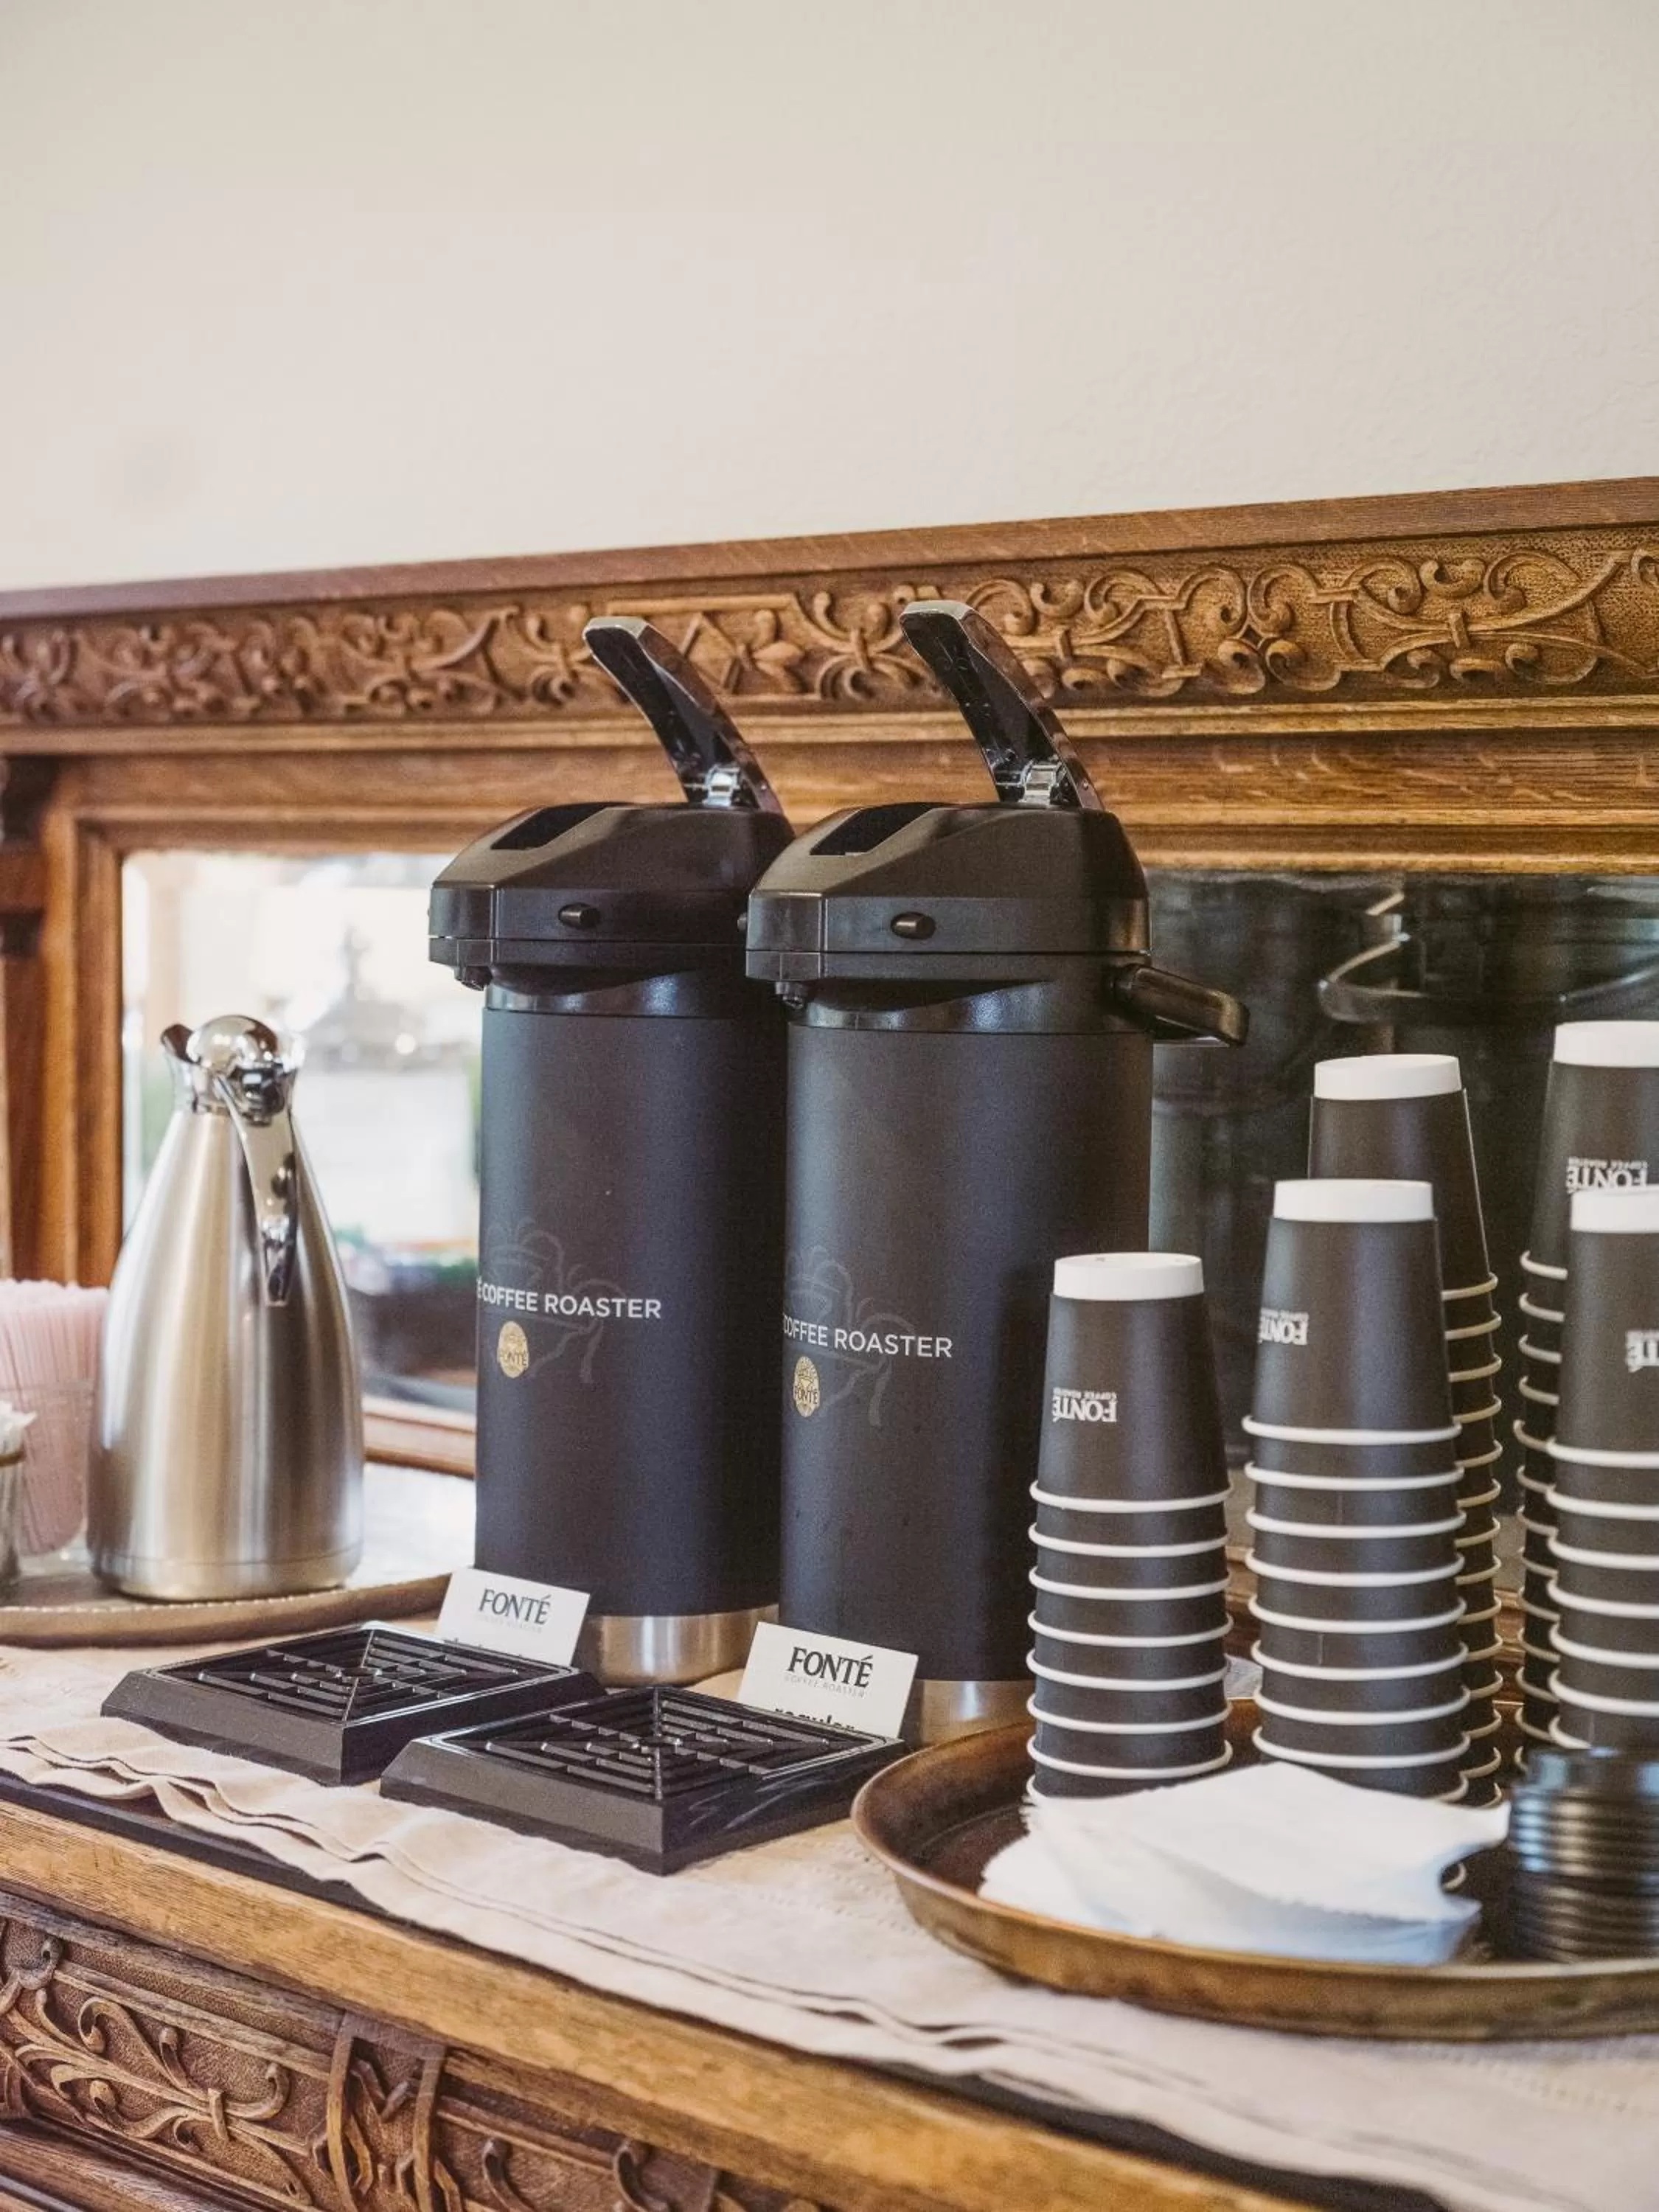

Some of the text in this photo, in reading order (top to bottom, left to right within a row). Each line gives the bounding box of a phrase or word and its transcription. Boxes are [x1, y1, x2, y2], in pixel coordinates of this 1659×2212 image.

[482, 1281, 539, 1312] COFFEE
[544, 1294, 661, 1318] ROASTER
[834, 1328, 953, 1357] ROASTER
[1051, 1394, 1117, 1422] FONTÉ
[479, 1588, 552, 1625] FONTÉ
[787, 1646, 873, 1688] FONTÉ
